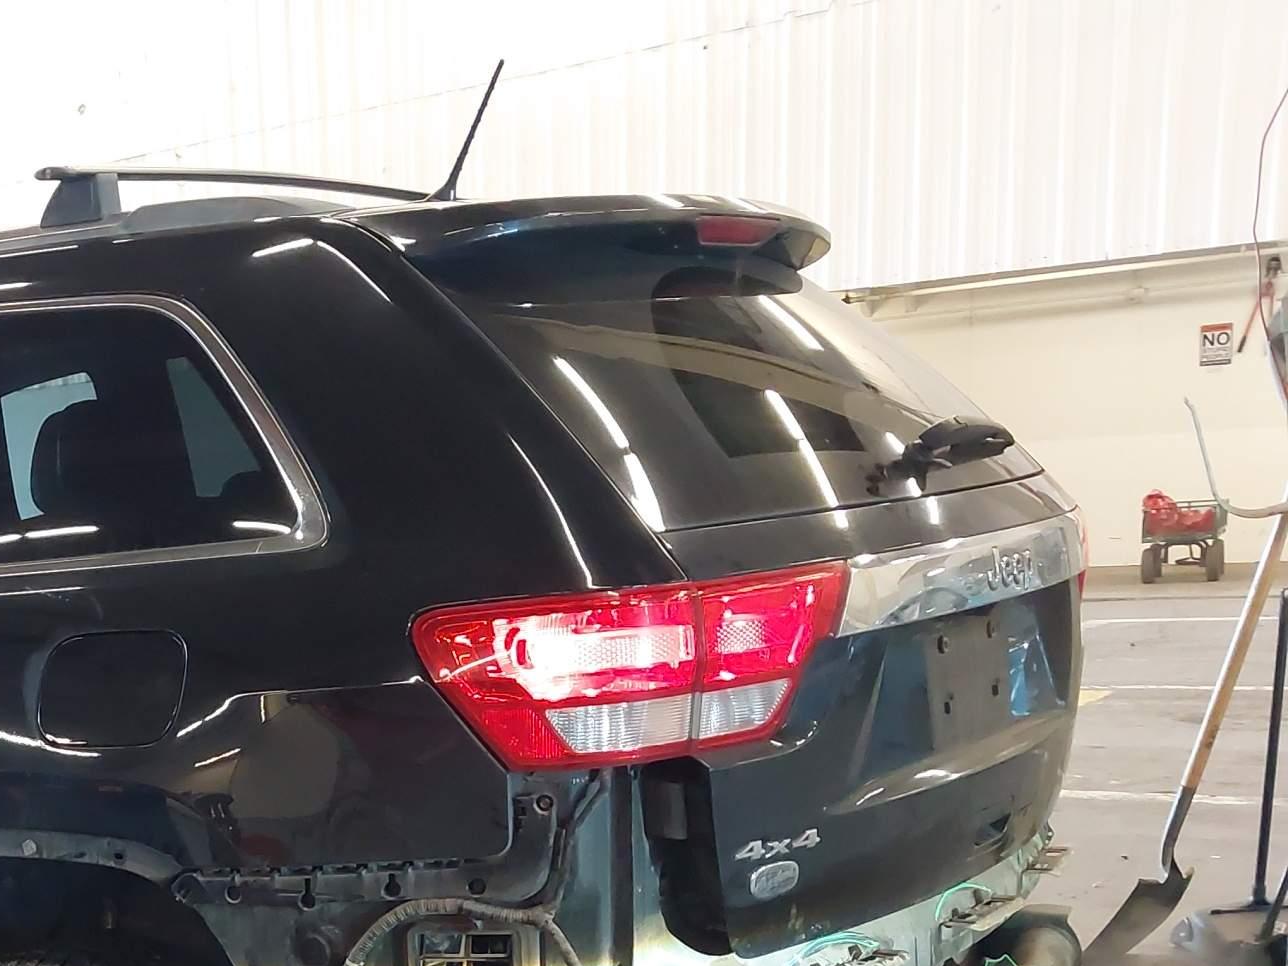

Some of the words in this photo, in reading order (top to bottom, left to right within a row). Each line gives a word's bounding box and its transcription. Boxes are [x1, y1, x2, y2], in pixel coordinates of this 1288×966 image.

[1202, 332, 1230, 347] NO
[987, 546, 1032, 591] Jeep
[735, 828, 821, 860] 4x4
